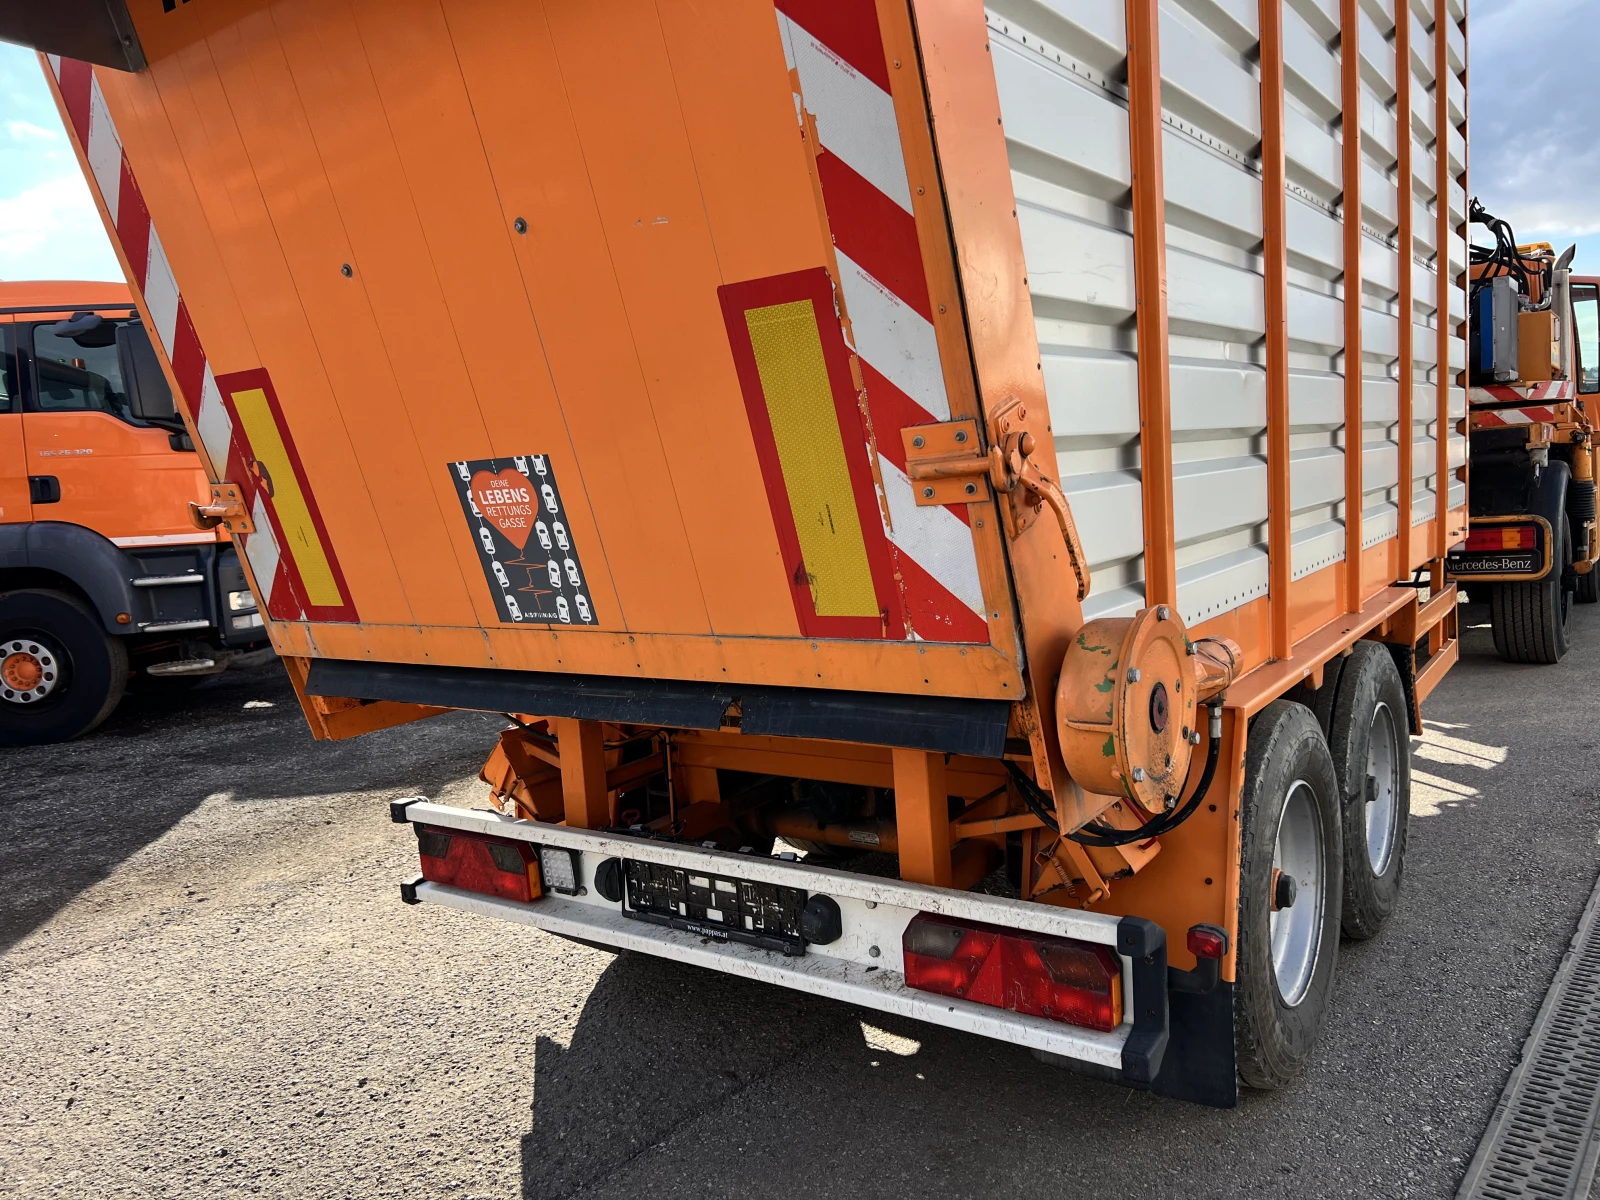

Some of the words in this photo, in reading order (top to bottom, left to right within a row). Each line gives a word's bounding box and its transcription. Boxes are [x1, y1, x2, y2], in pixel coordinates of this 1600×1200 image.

[490, 479, 509, 488] DEINE
[478, 488, 530, 504] LEBENS
[486, 505, 532, 517] RETTUNGS
[499, 517, 527, 529] GASSE
[1445, 559, 1531, 570] Mercedes-Benz
